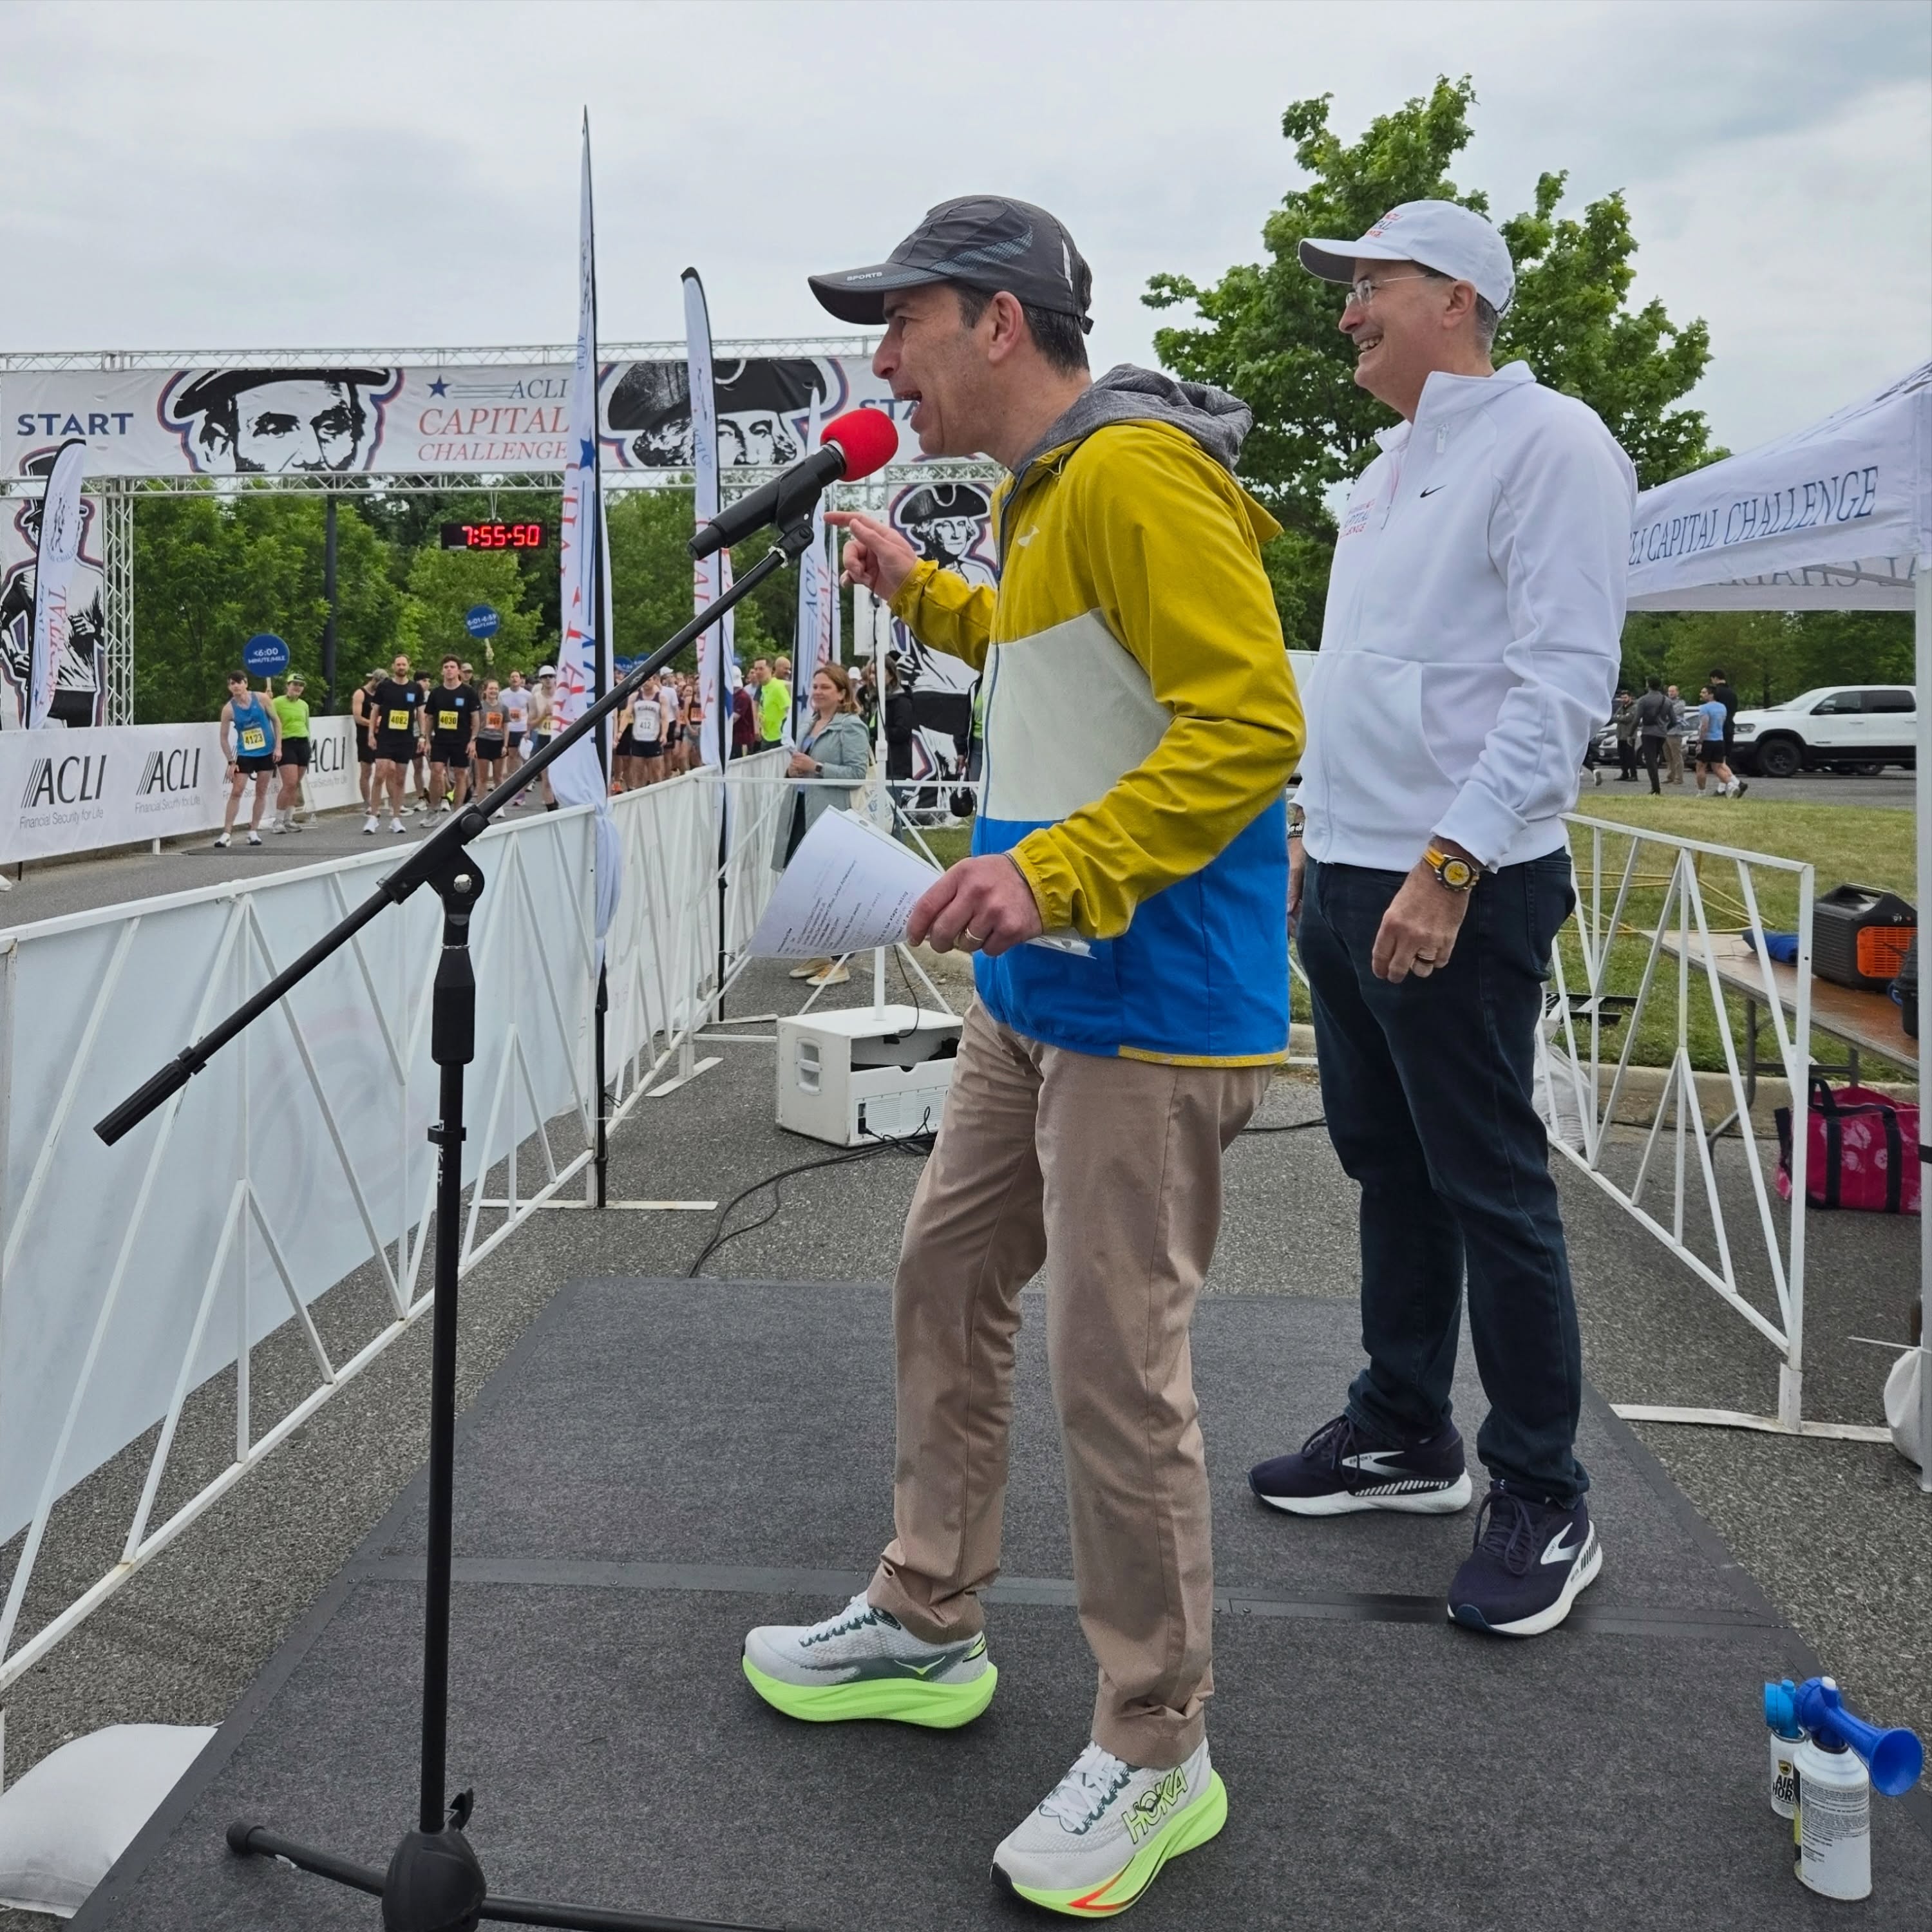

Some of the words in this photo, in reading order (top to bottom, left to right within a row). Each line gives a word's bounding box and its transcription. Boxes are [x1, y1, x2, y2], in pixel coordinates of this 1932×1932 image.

[847, 271, 883, 281] SPORTS
[509, 379, 570, 399] ACLI
[17, 412, 134, 436] START
[419, 406, 570, 436] CAPITAL
[418, 440, 567, 461] CHALLENGE
[1648, 508, 1719, 562] CAPITAL
[1724, 465, 1879, 545] CHALLENGE
[254, 647, 279, 657] <6:00
[390, 715, 407, 724] 4082
[639, 721, 651, 729] 412
[245, 734, 263, 744] 4123
[307, 736, 346, 774] ACLI
[31, 754, 107, 808] ACLI
[146, 747, 201, 795] ACLI
[19, 814, 51, 829] Financial
[52, 811, 80, 825] Security
[82, 808, 91, 821] for
[92, 807, 104, 820] Life
[1772, 1781, 1794, 1802] HOR
[1776, 1774, 1794, 1790] AIR
[1121, 1765, 1189, 1844] HOKA
